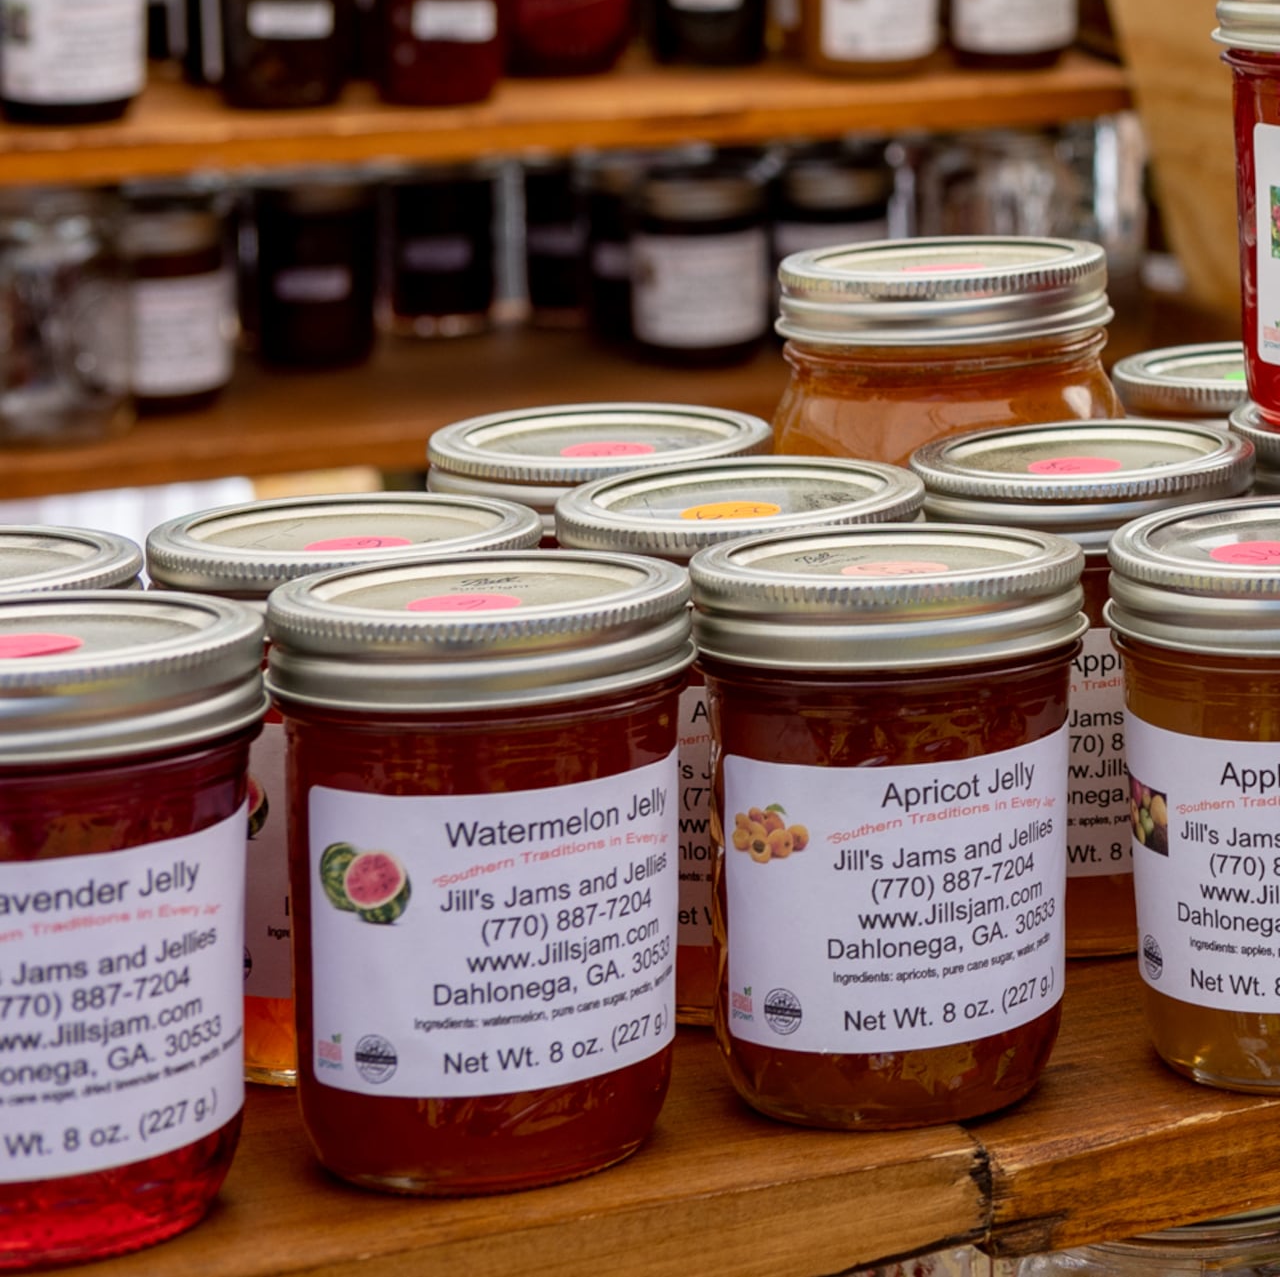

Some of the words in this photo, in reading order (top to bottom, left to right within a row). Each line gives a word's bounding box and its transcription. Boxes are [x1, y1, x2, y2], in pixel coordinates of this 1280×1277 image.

[881, 774, 979, 811] Apricot
[988, 762, 1034, 792] Jelly
[446, 808, 618, 848] Watermelon
[627, 788, 666, 820] Jelly
[834, 850, 883, 871] Jill's
[892, 846, 956, 869] Jams
[964, 833, 1001, 860] and
[1009, 818, 1053, 850] Jellies
[1181, 820, 1220, 845] Jill's
[0, 879, 129, 914] avender
[139, 861, 200, 897] Jelly
[440, 891, 494, 912] Jill's
[504, 882, 570, 907] Jams
[579, 868, 616, 897] and
[624, 853, 666, 885] Jellies
[871, 876, 935, 904] (770)
[943, 853, 1034, 893] 887-7204
[1209, 853, 1265, 881] (770)
[482, 914, 548, 946] (770)
[556, 888, 651, 931] 887-7204
[828, 935, 964, 959] Dahlonega,
[971, 921, 1008, 946] GA.
[1015, 898, 1055, 935] 30533
[858, 882, 1042, 930] www.Jillsjam.com
[11, 963, 88, 986] Jams
[98, 949, 147, 975] and
[155, 928, 217, 963] Jellies
[433, 976, 577, 1006] Dahlonega,
[586, 961, 625, 986] GA.
[632, 935, 670, 973] 30533
[467, 918, 659, 972] www.Jillsjam.com
[1241, 944, 1275, 958] apples,
[72, 967, 191, 1011] 887-7204
[845, 1010, 885, 1031] Net
[893, 1008, 933, 1028] Wt.
[943, 1003, 955, 1023] 8
[964, 998, 994, 1020] oz.
[1002, 980, 1036, 1013] (227
[1040, 967, 1055, 997] g.)
[1190, 968, 1223, 993] Net
[1229, 975, 1265, 996] Wt.
[107, 1047, 155, 1071] GA.
[165, 1016, 222, 1057] 30533
[444, 1054, 488, 1074] Net
[497, 1048, 539, 1069] Wt.
[550, 1042, 563, 1062] 8
[572, 1038, 603, 1058] oz.
[611, 1015, 651, 1052] (227
